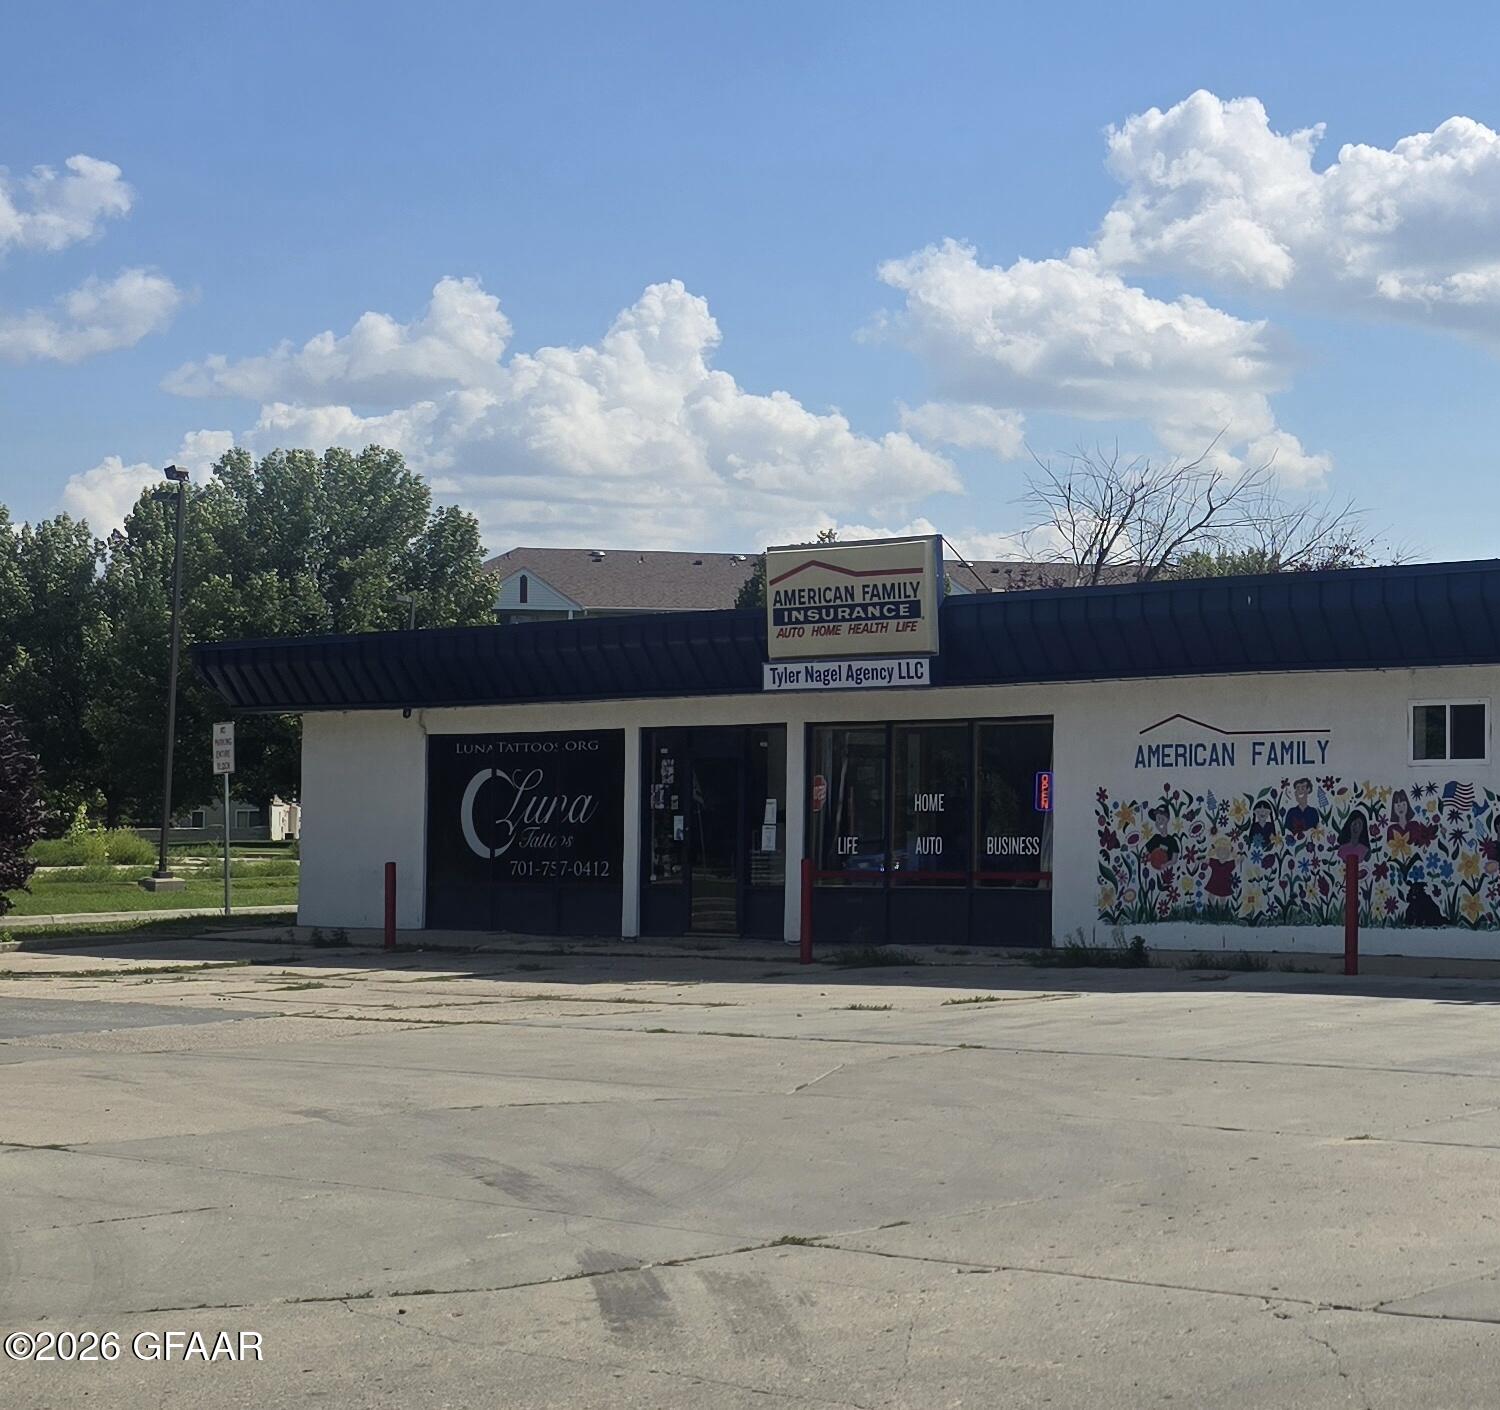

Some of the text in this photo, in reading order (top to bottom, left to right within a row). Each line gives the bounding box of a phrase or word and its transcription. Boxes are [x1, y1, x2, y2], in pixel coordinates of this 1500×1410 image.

[773, 581, 920, 607] AMERICAN FAMILY
[783, 603, 910, 623] INSURANCE
[776, 620, 918, 639] AUTO HOME HEALTH LIFE
[769, 661, 924, 687] Tyler Nagel Agency LLC
[1134, 740, 1330, 769] AMERICAN FAMILY
[1041, 773, 1049, 809] OPEN
[496, 768, 599, 835] Luna
[914, 793, 945, 812] HOME
[518, 826, 574, 849] Tattoos
[837, 836, 859, 855] LIFE
[915, 836, 943, 855] AUTO
[986, 836, 1040, 856] BUSINESS
[510, 860, 609, 877] 701-757-0412
